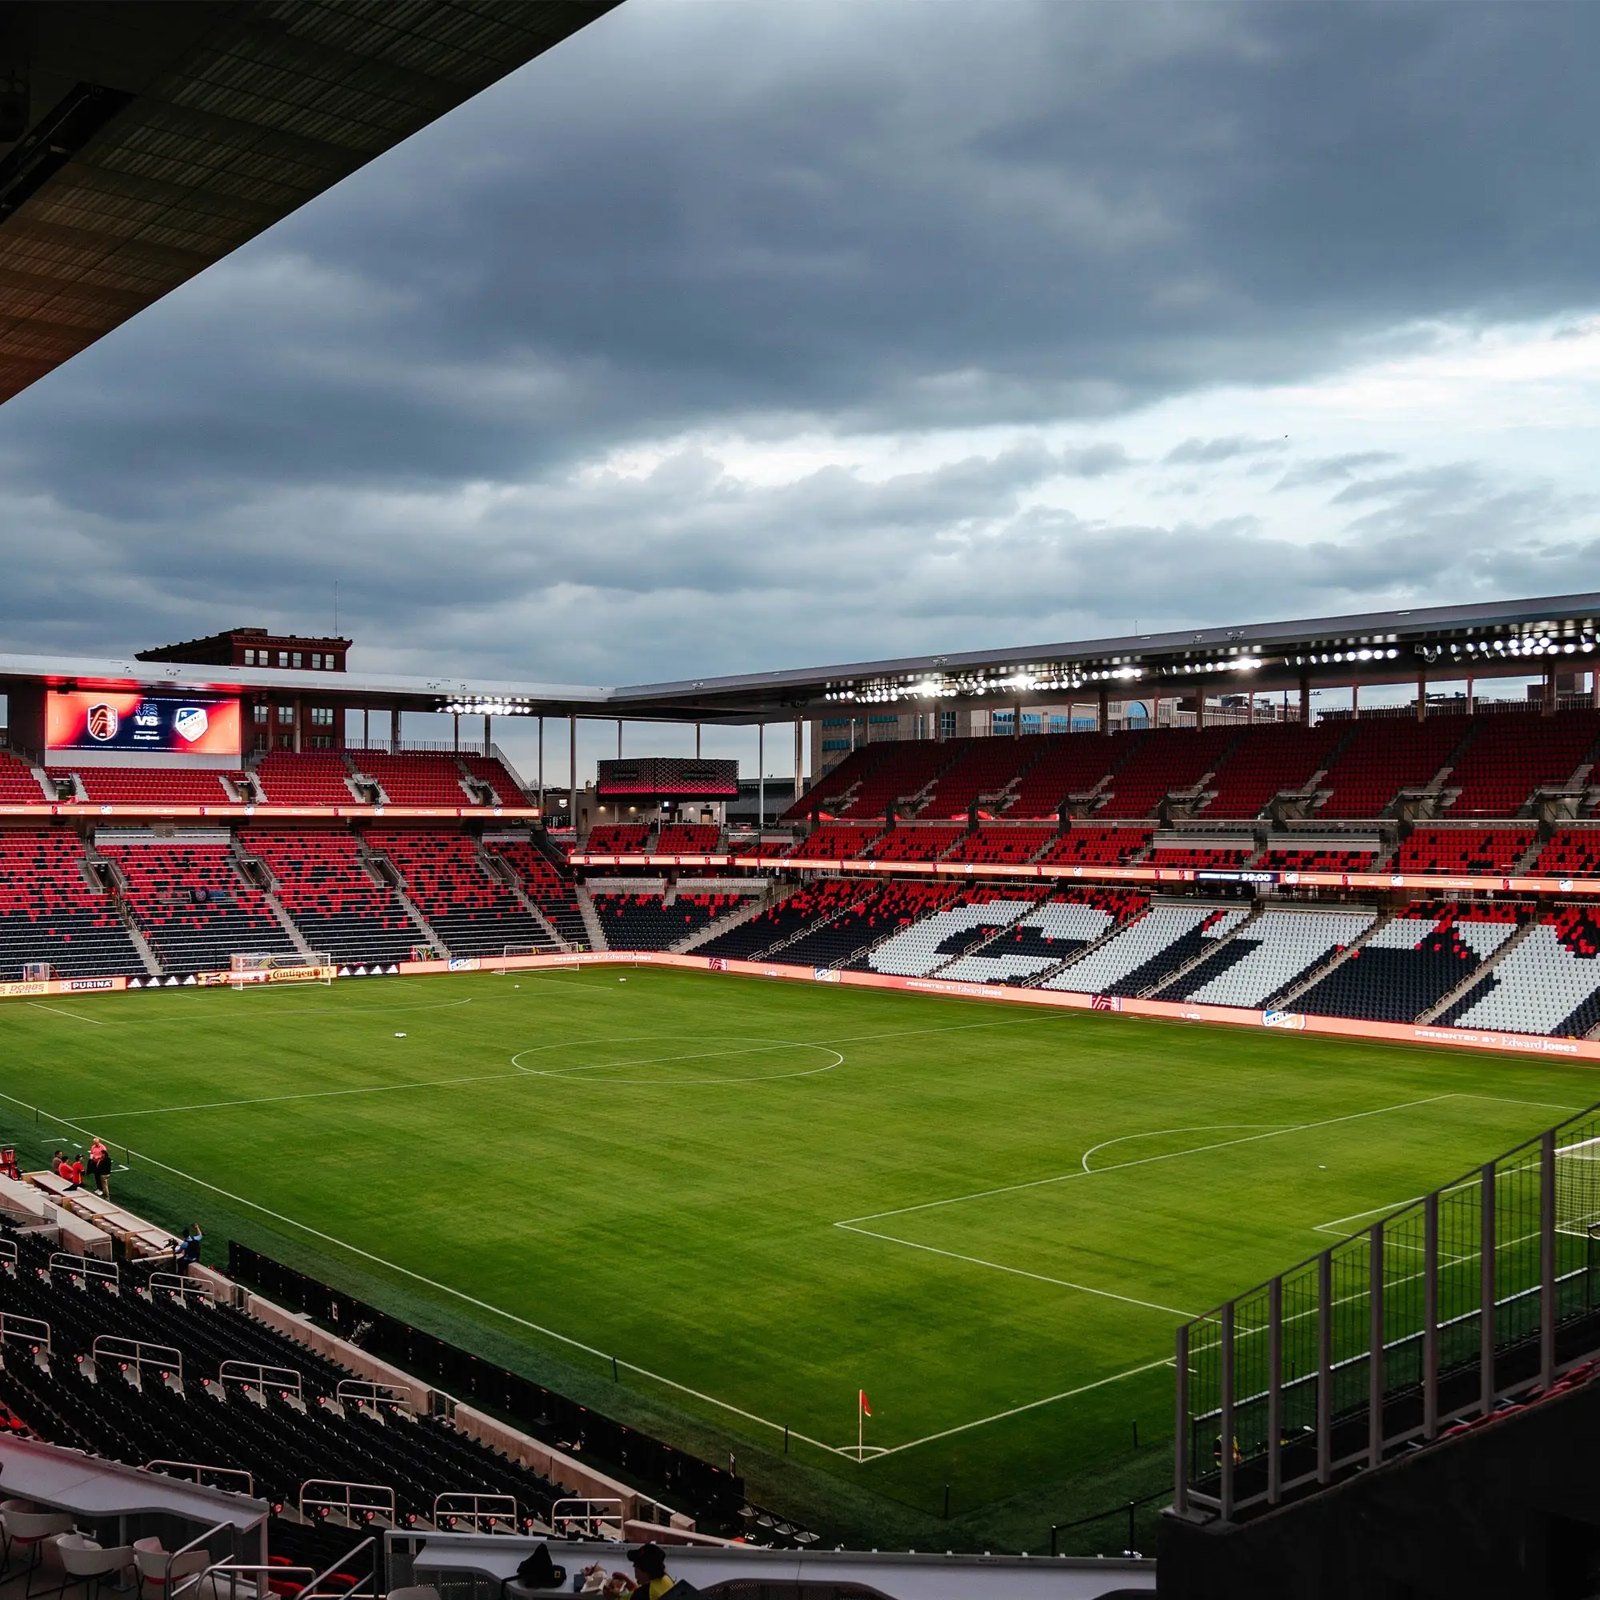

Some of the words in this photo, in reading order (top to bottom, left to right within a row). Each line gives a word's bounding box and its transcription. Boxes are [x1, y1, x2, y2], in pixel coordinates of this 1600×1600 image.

[135, 715, 158, 726] VS
[273, 967, 324, 979] Continenl
[11, 983, 45, 992] DOBBS
[73, 980, 111, 988] PURINA
[907, 981, 945, 990] PRESENTED
[958, 984, 981, 995] Edward
[982, 987, 1003, 996] Jones
[1415, 1030, 1478, 1042] PRESENTED
[1502, 1036, 1541, 1050] Edward
[1542, 1040, 1577, 1053] Jones
